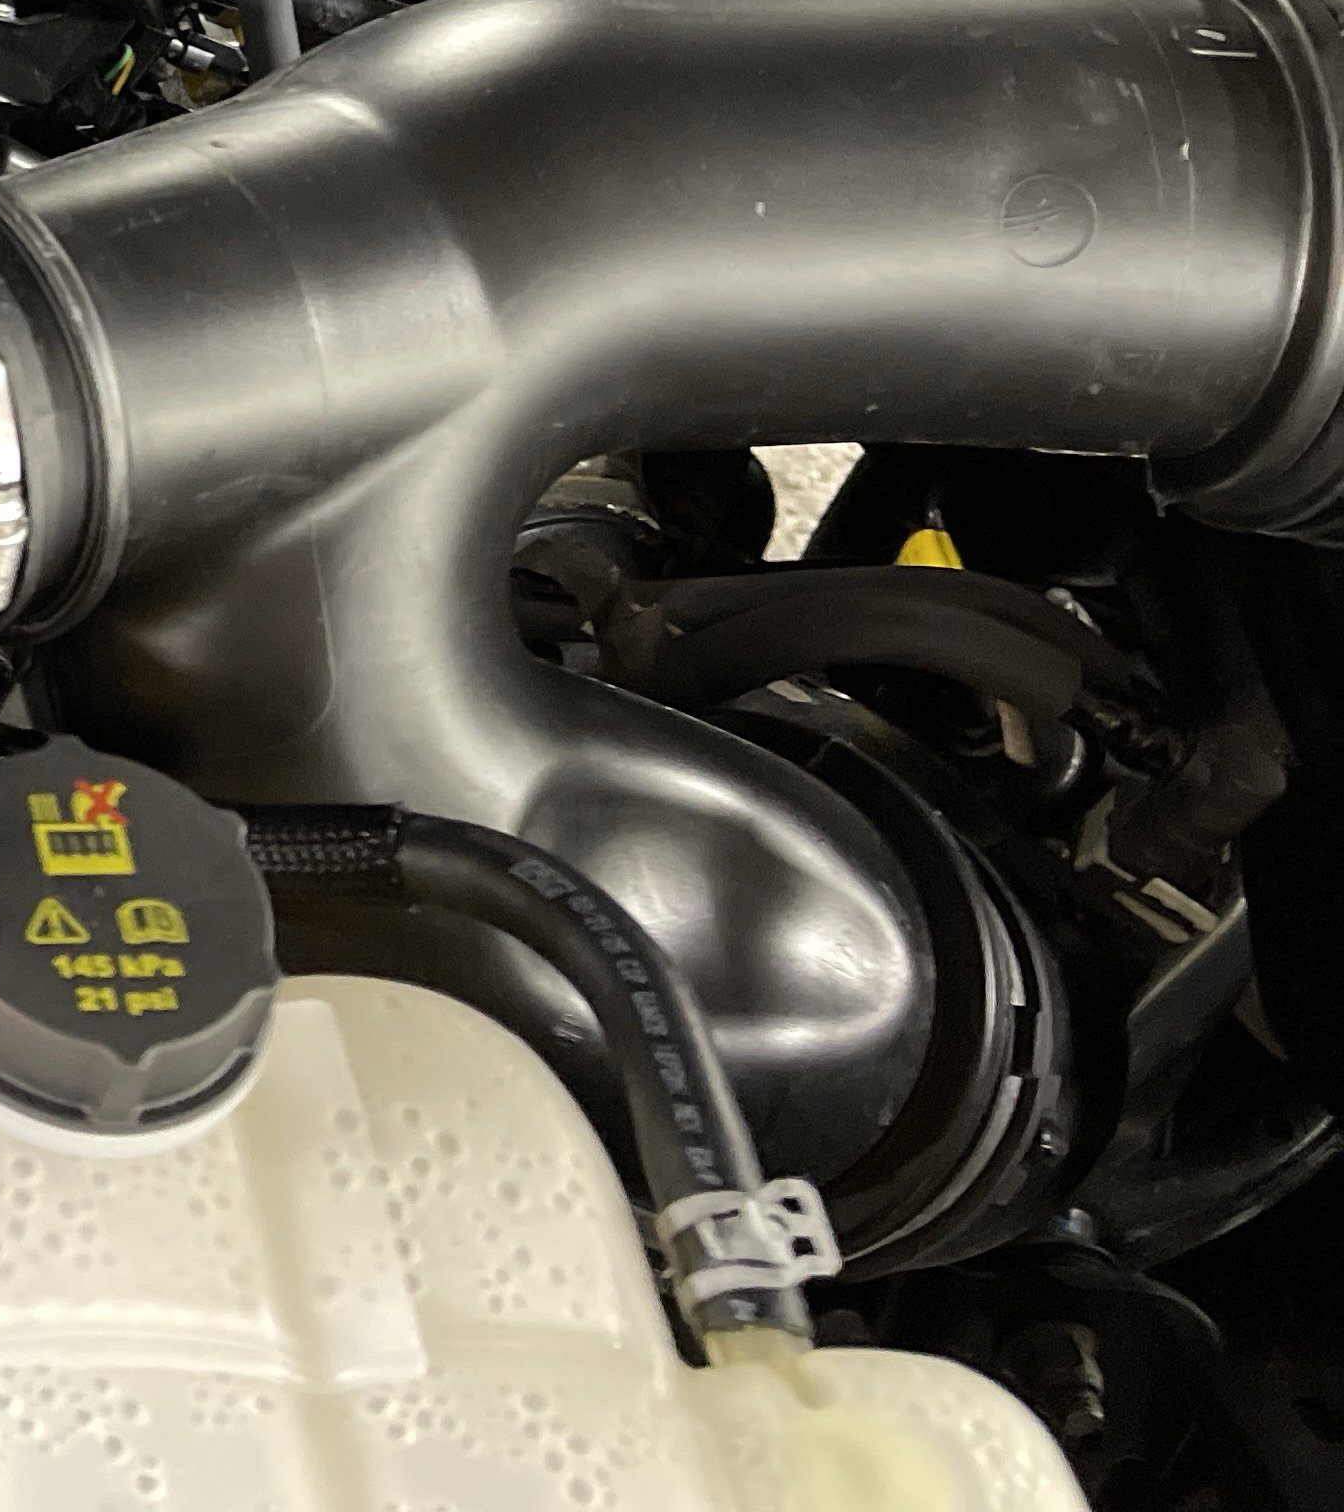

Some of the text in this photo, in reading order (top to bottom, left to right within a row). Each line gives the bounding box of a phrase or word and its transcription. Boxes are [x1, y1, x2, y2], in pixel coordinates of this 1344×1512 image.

[51, 952, 187, 979] 145 kPa
[74, 987, 179, 1017] 21 psi
